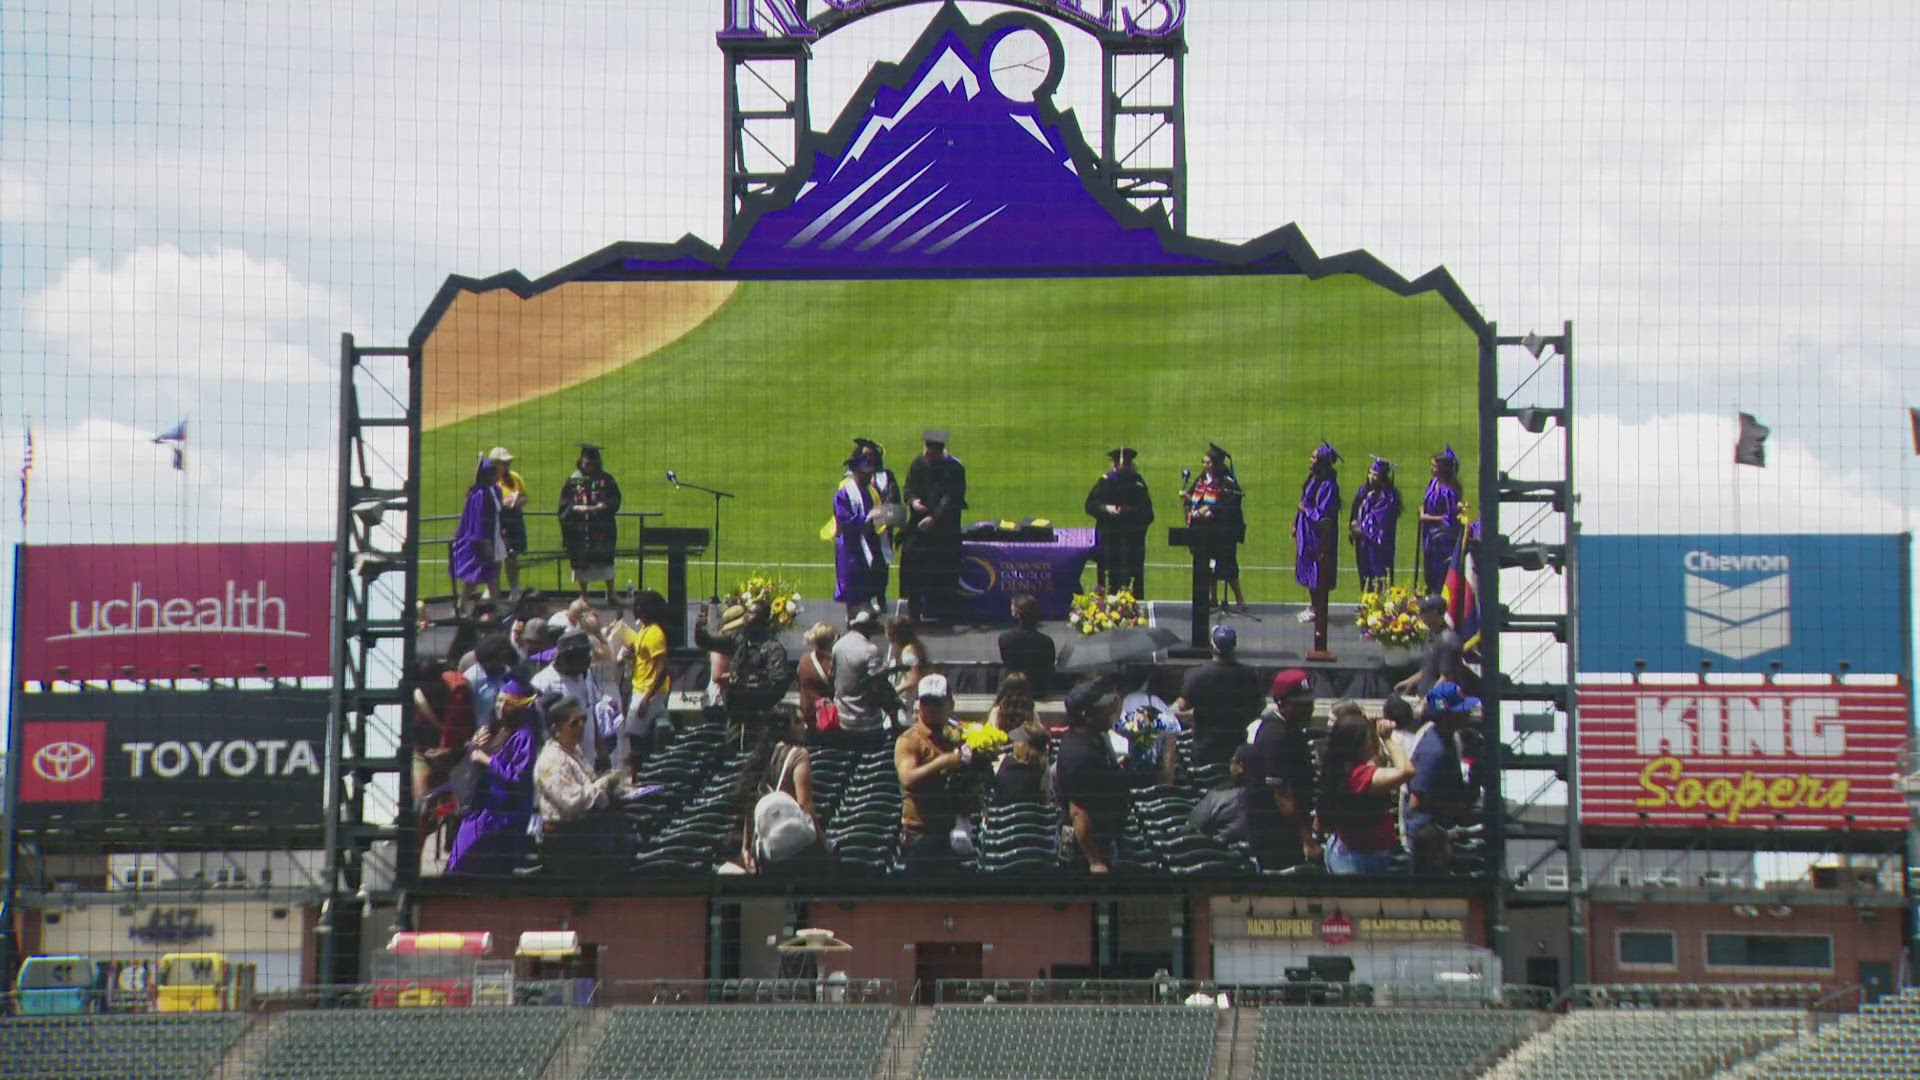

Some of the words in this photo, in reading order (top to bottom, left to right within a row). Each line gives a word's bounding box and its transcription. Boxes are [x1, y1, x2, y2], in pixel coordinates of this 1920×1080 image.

[1684, 551, 1789, 572] Chevron
[70, 580, 286, 632] uchealth
[1635, 697, 1846, 756] KING
[121, 739, 320, 778] TOYOTA
[1635, 757, 1851, 822] Soopers
[1247, 919, 1275, 936] NACHO
[1276, 919, 1313, 937] SUPREME
